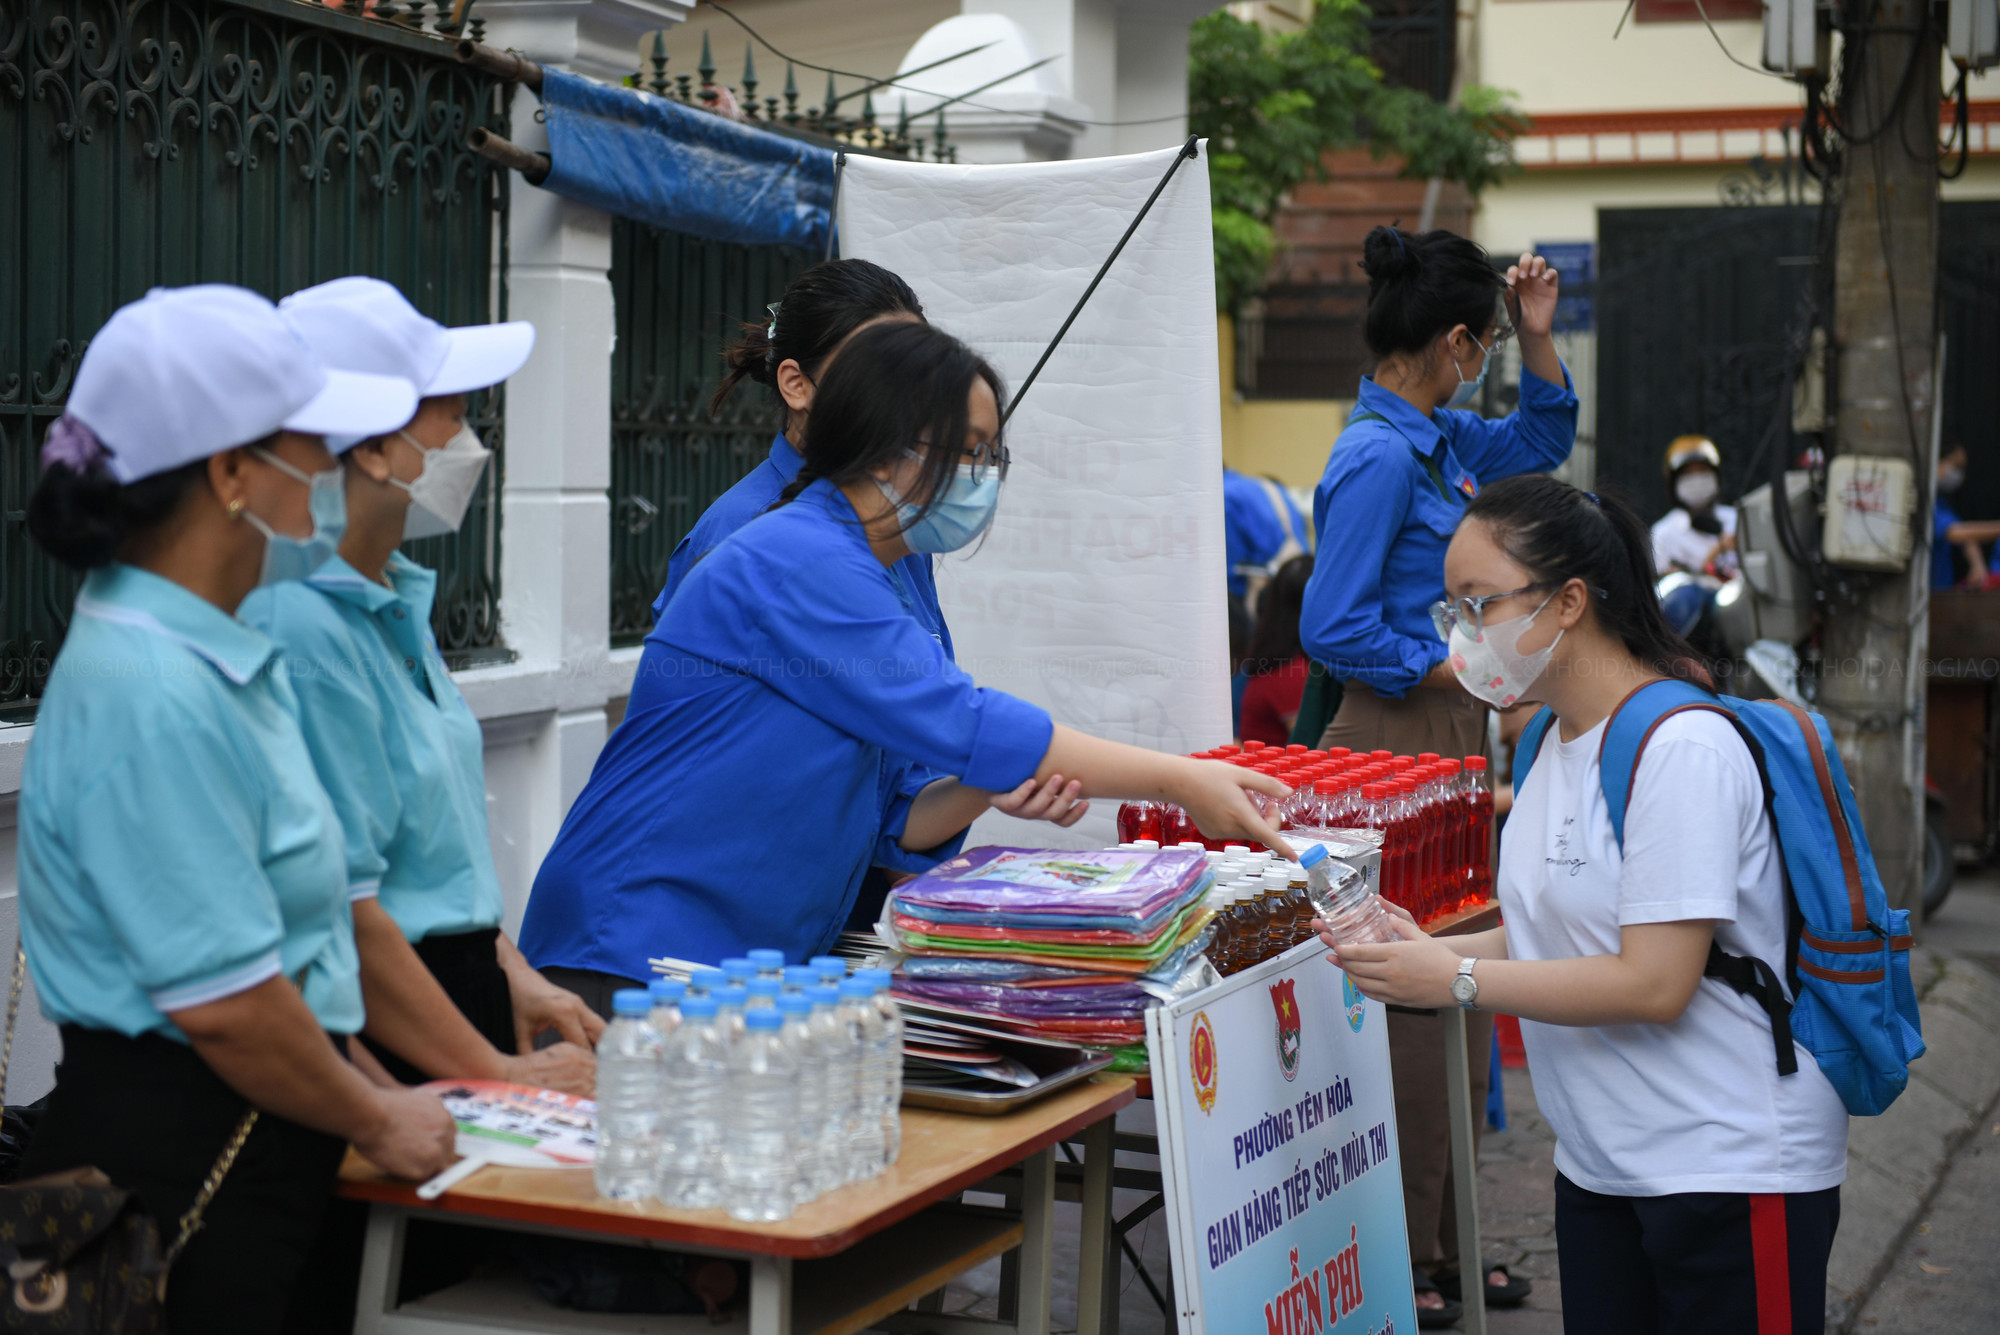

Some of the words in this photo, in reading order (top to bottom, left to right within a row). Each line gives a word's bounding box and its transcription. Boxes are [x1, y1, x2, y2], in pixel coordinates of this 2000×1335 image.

[1234, 1112, 1294, 1169] PHƯỜNG
[1296, 1091, 1324, 1133] YÊN
[1326, 1075, 1353, 1118] HÒA
[1207, 1210, 1243, 1270] GIAN
[1243, 1190, 1282, 1246] HÀNG
[1283, 1159, 1311, 1220] TIẾP
[1314, 1148, 1340, 1201] SỨC
[1341, 1131, 1369, 1185] MÙA
[1368, 1122, 1388, 1166] THI
[1325, 1224, 1364, 1325] PHÍ
